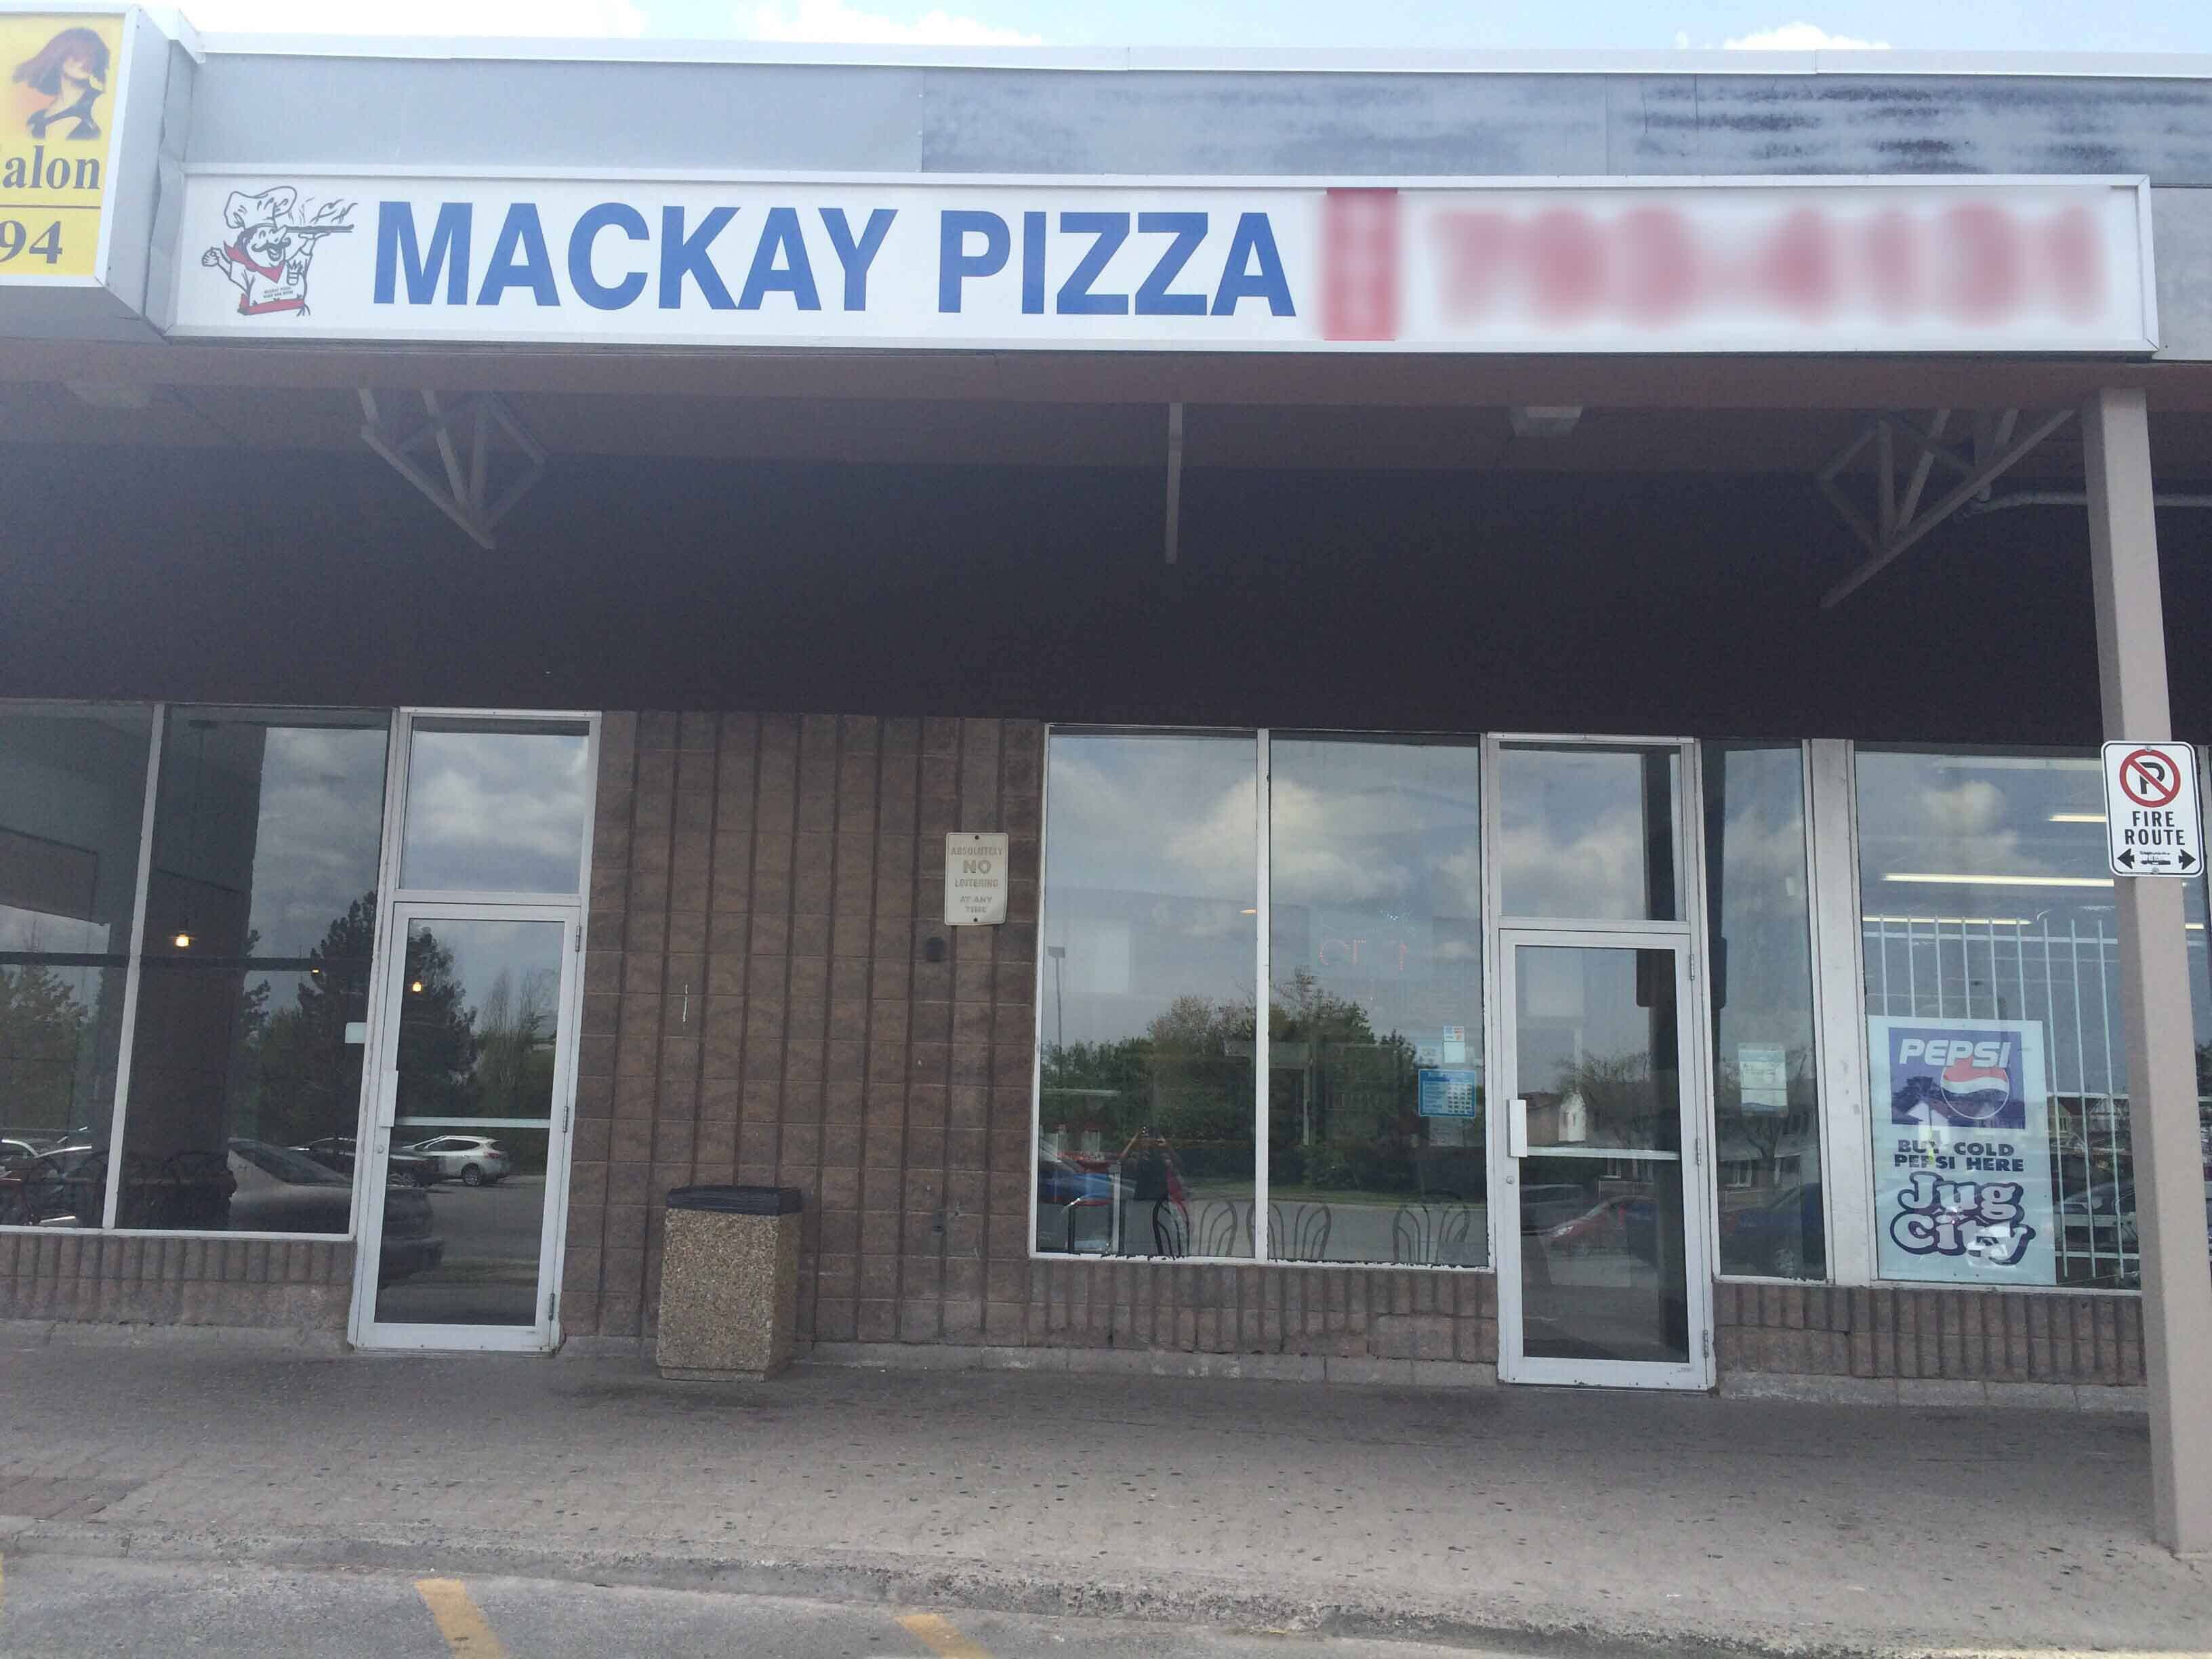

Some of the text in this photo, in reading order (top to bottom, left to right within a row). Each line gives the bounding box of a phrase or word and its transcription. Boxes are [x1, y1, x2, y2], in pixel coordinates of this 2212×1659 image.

[0, 144, 101, 190] alon
[373, 201, 1296, 317] MACKAY PIZZA
[2132, 811, 2175, 827] FIRE
[2125, 828, 2186, 846] ROUTE
[951, 846, 1003, 856] ABSOLUTELY
[962, 859, 991, 874] NO
[954, 878, 998, 888] LOITERING
[960, 895, 993, 904] AT ANY
[1898, 1038, 2011, 1069] PEPSI
[1953, 1141, 2015, 1157] COLD
[1894, 1153, 2024, 1172] PEPSI HERE
[1898, 1171, 2024, 1221] Jug
[1889, 1210, 2036, 1266] City
